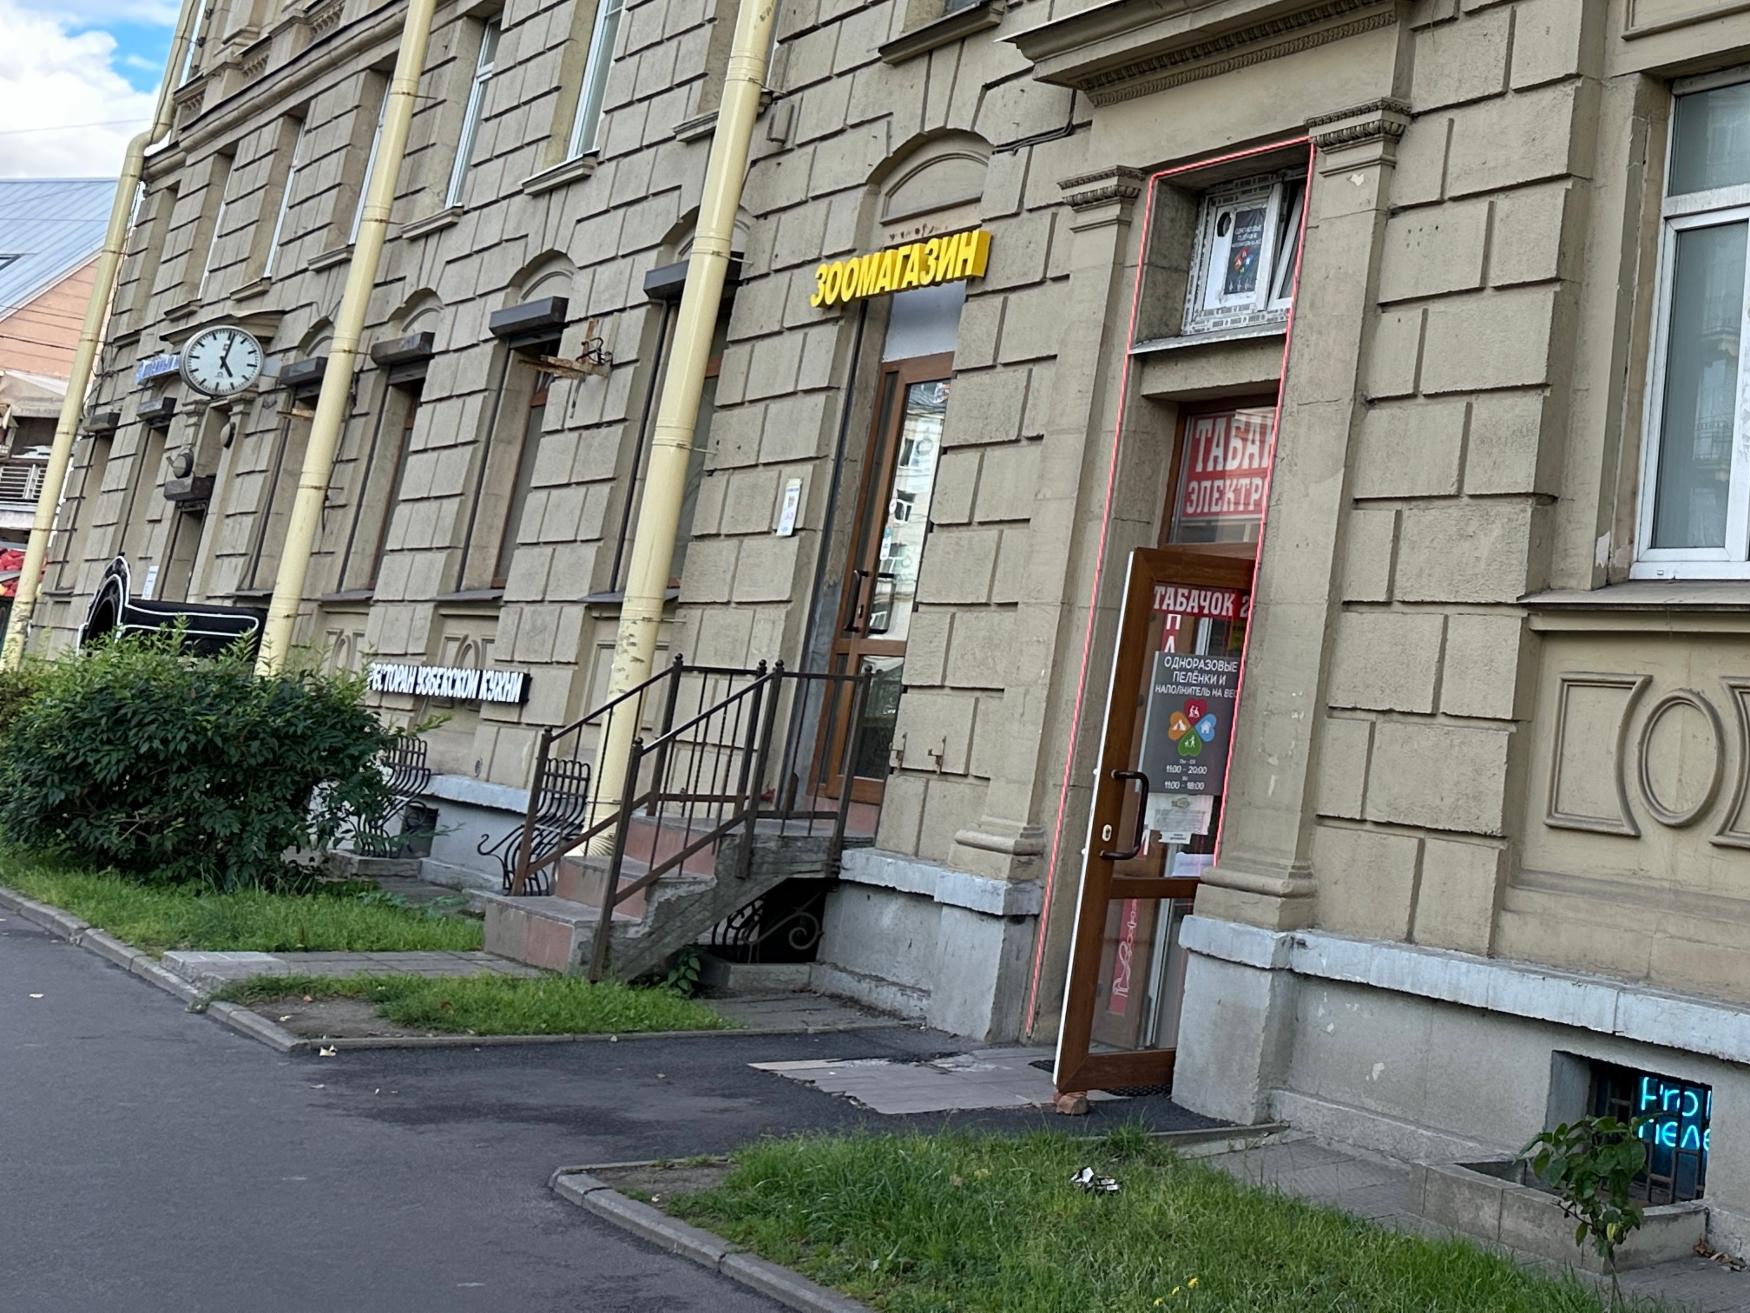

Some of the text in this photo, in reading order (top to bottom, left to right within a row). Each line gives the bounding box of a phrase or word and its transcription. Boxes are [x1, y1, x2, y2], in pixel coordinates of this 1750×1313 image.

[810, 229, 991, 308] ЗООМАГАЗИН
[1153, 586, 1235, 616] ТАБАЧОК
[1164, 656, 1238, 673] ОДНОРАЗОВЫЕ
[478, 669, 524, 703] КУХНИ
[1155, 684, 1211, 697] НАПОЛНИТЕЛЬ
